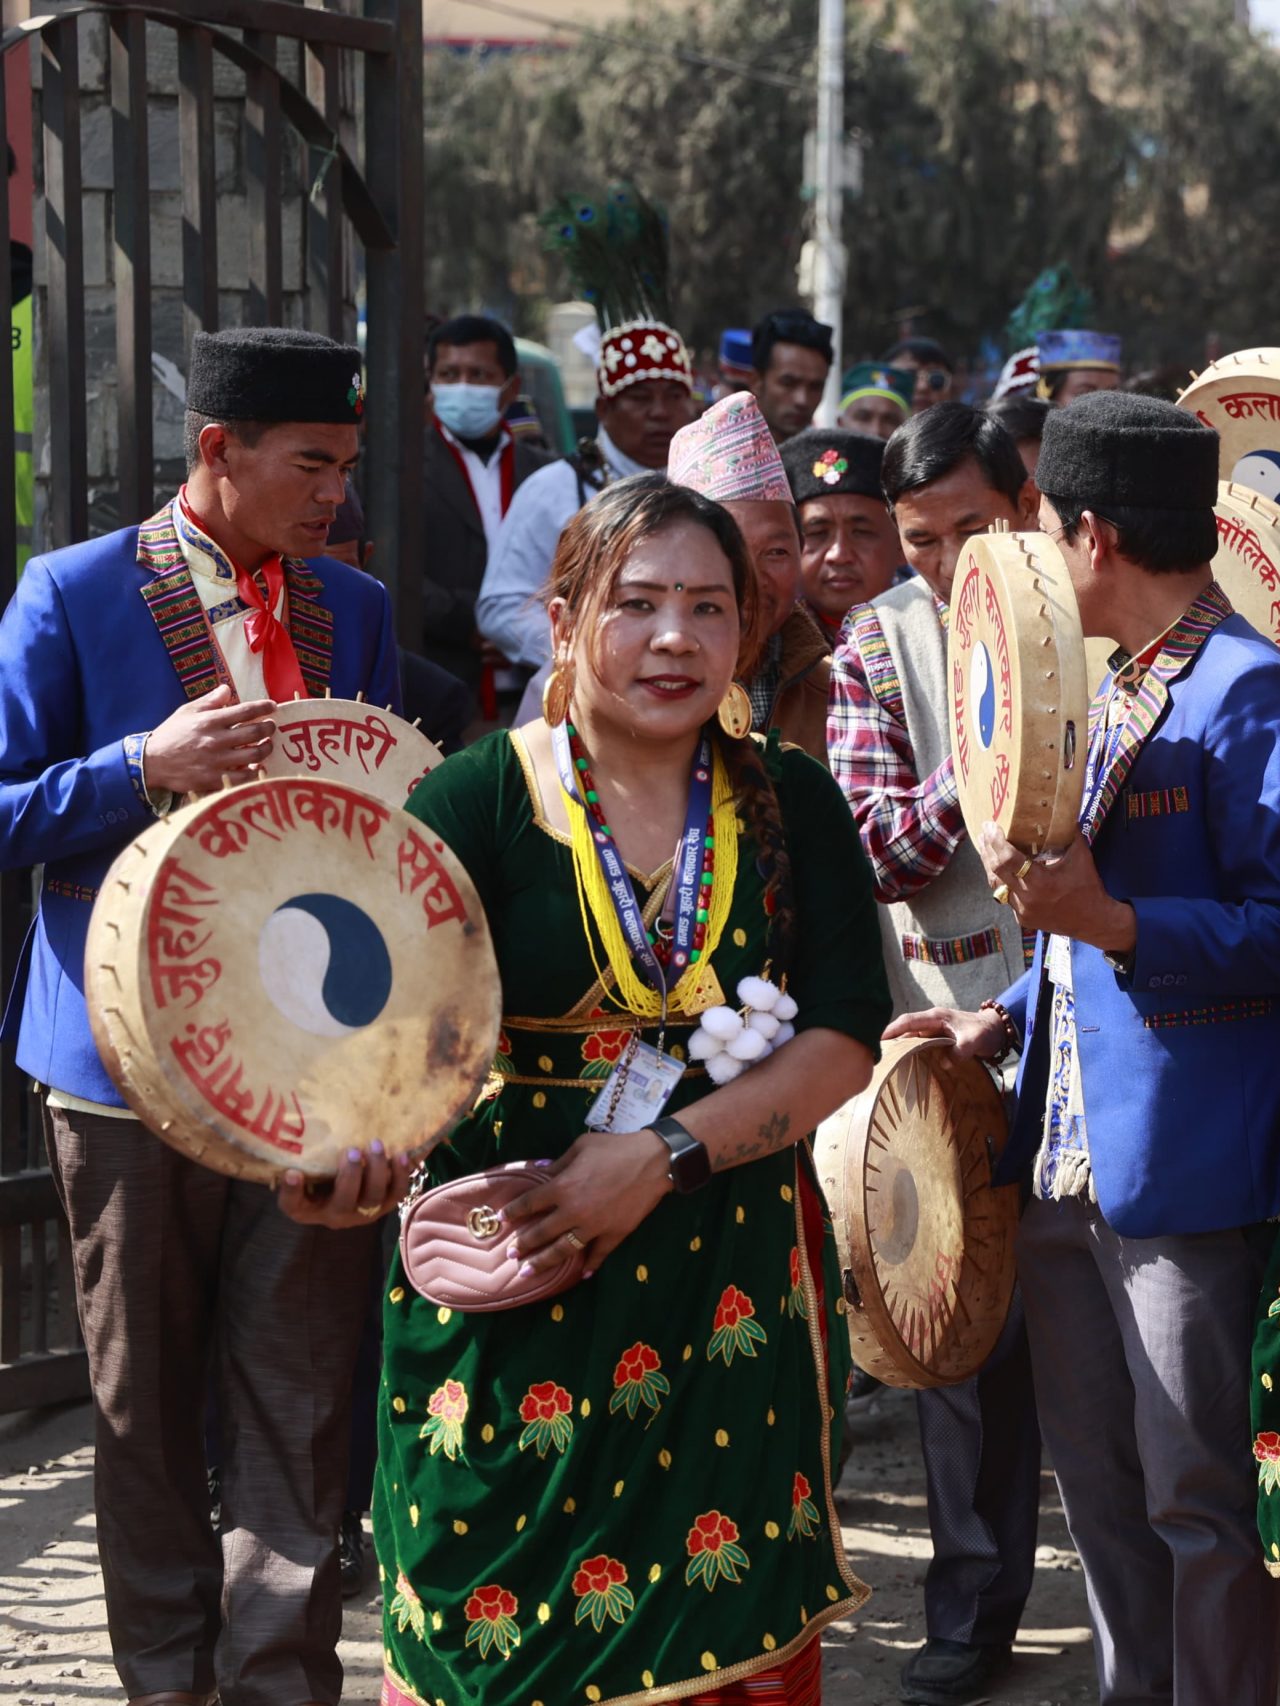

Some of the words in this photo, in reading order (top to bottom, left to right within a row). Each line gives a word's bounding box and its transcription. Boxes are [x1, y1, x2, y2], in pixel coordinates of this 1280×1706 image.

[985, 573, 1013, 739] कलाकार
[278, 715, 397, 775] जुहारी
[184, 779, 392, 861] कलाकार
[397, 827, 467, 931] संघ
